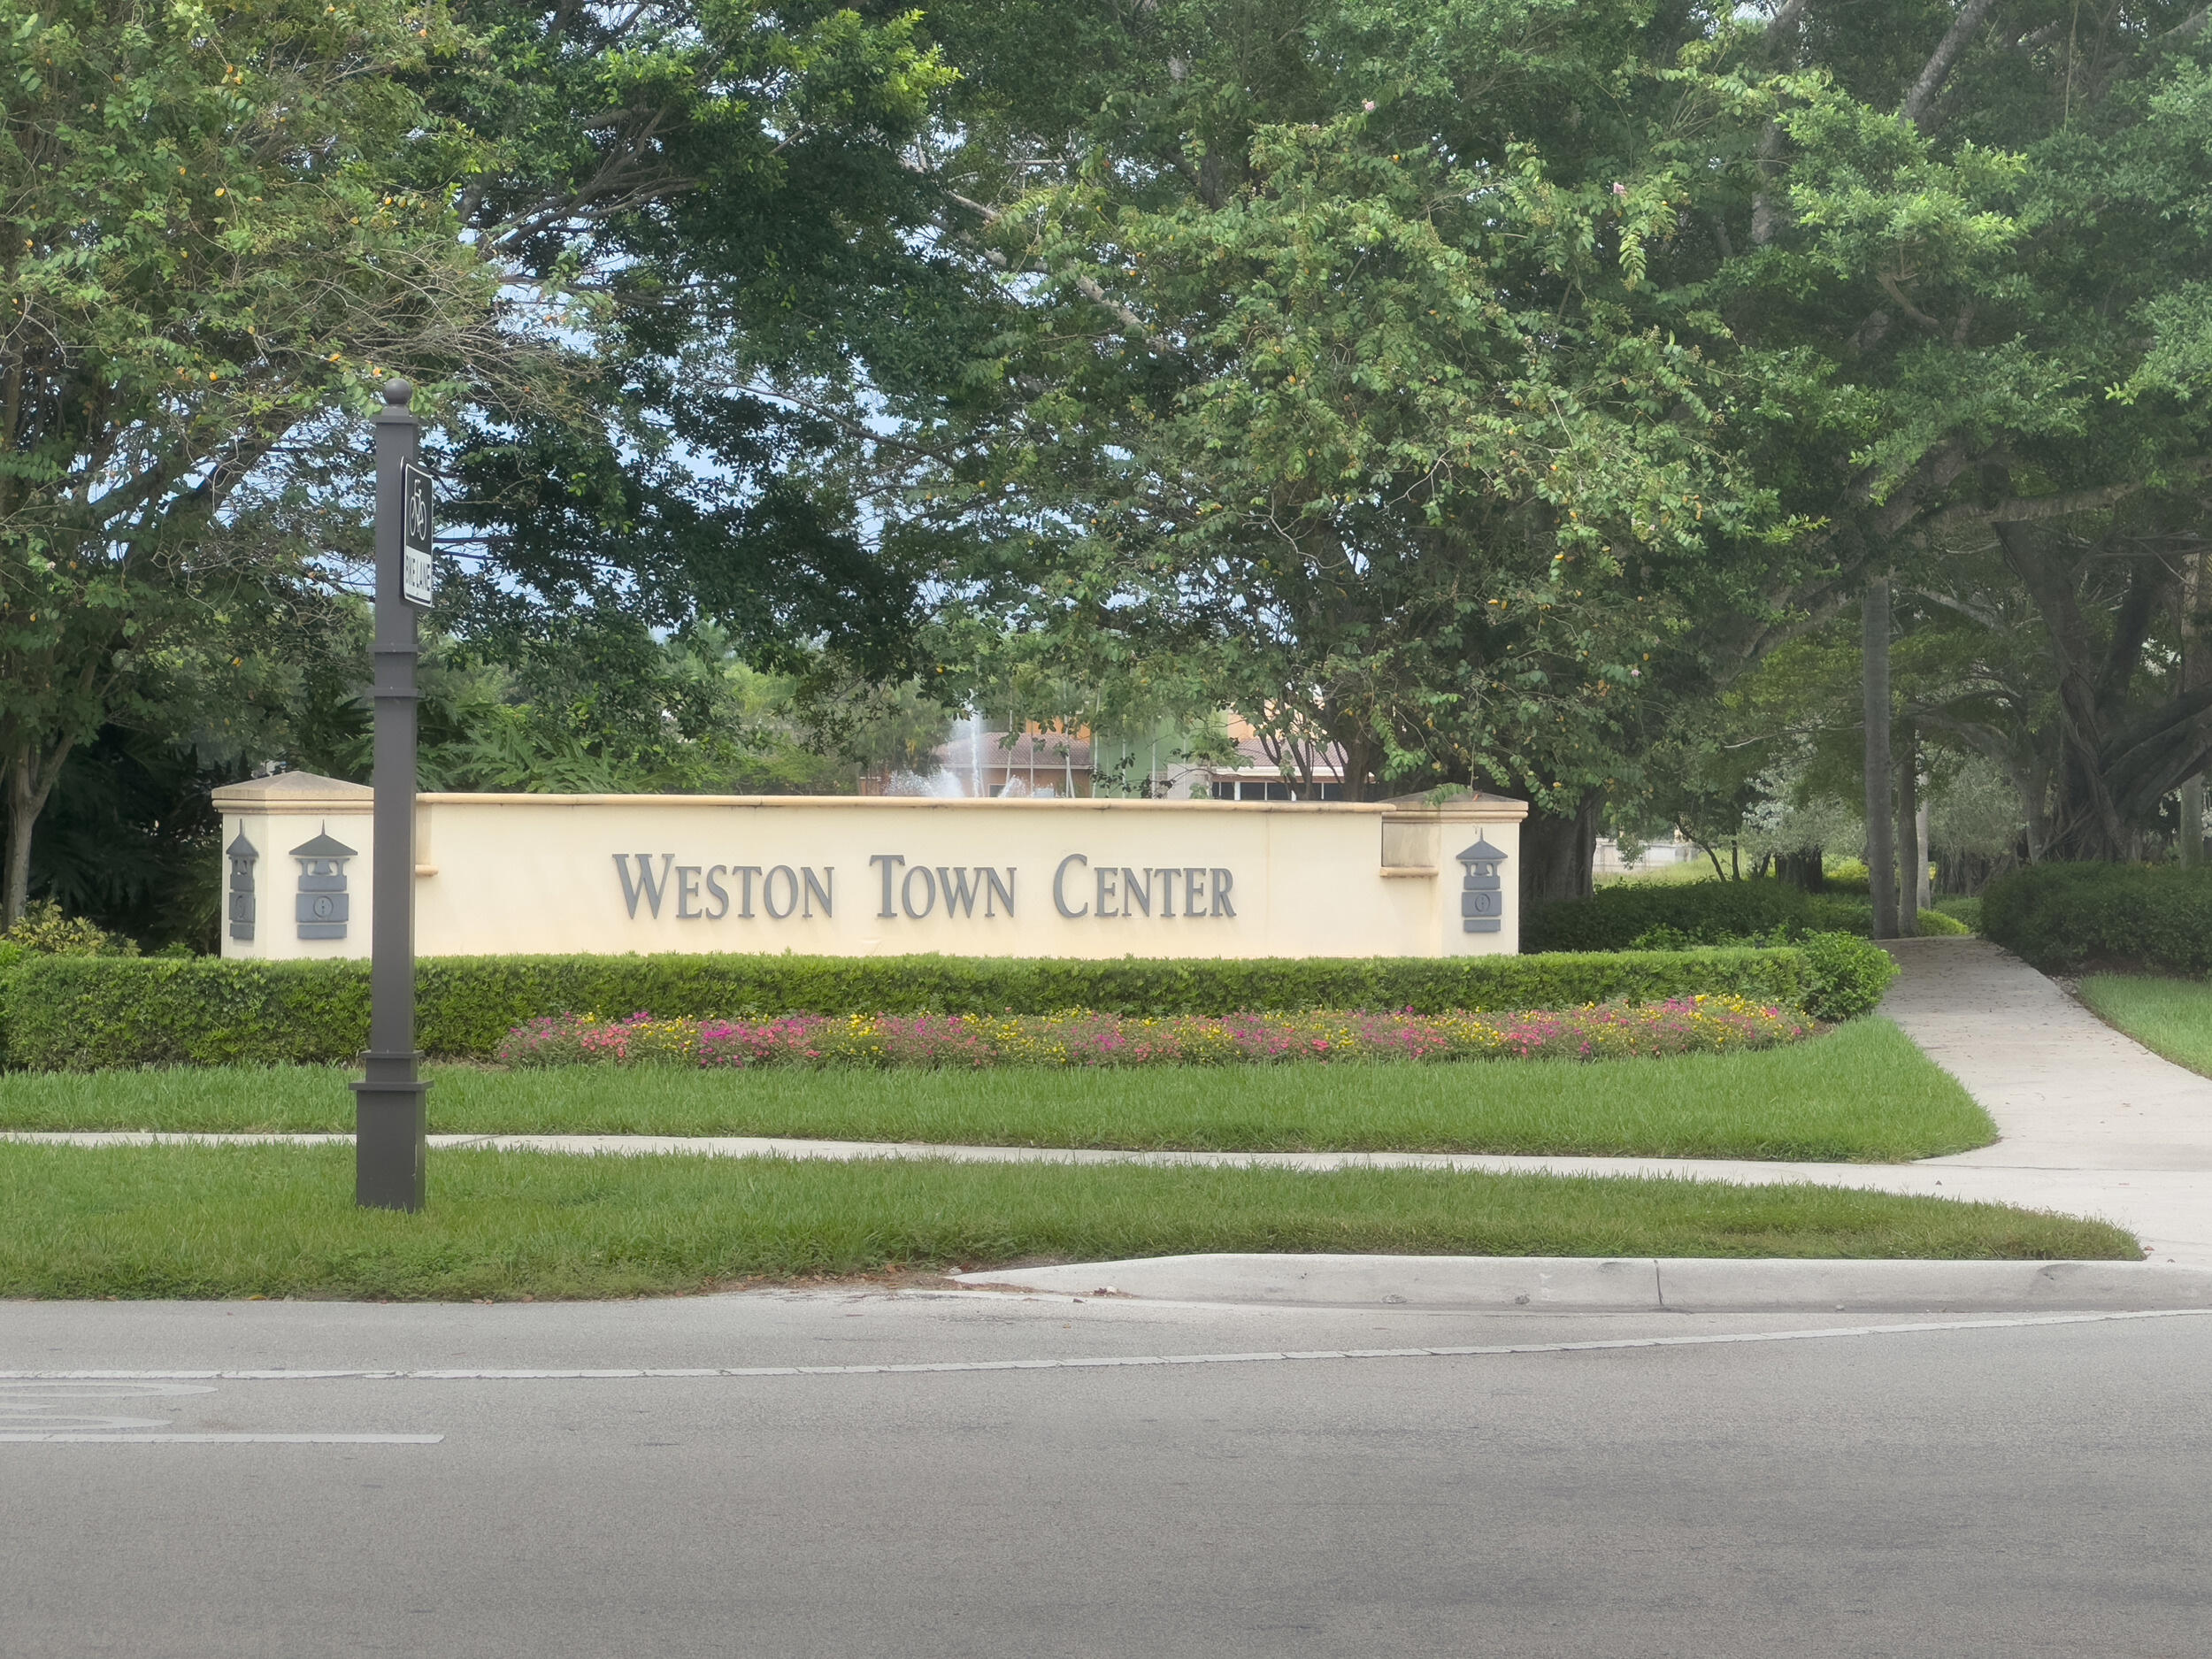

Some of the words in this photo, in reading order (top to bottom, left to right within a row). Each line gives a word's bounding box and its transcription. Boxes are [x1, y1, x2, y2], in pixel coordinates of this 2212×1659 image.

[405, 555, 416, 587] BIKE
[416, 559, 431, 592] LANE
[611, 853, 834, 919] WESTON
[869, 855, 1017, 918] TOWN
[1053, 853, 1236, 918] CENTER
